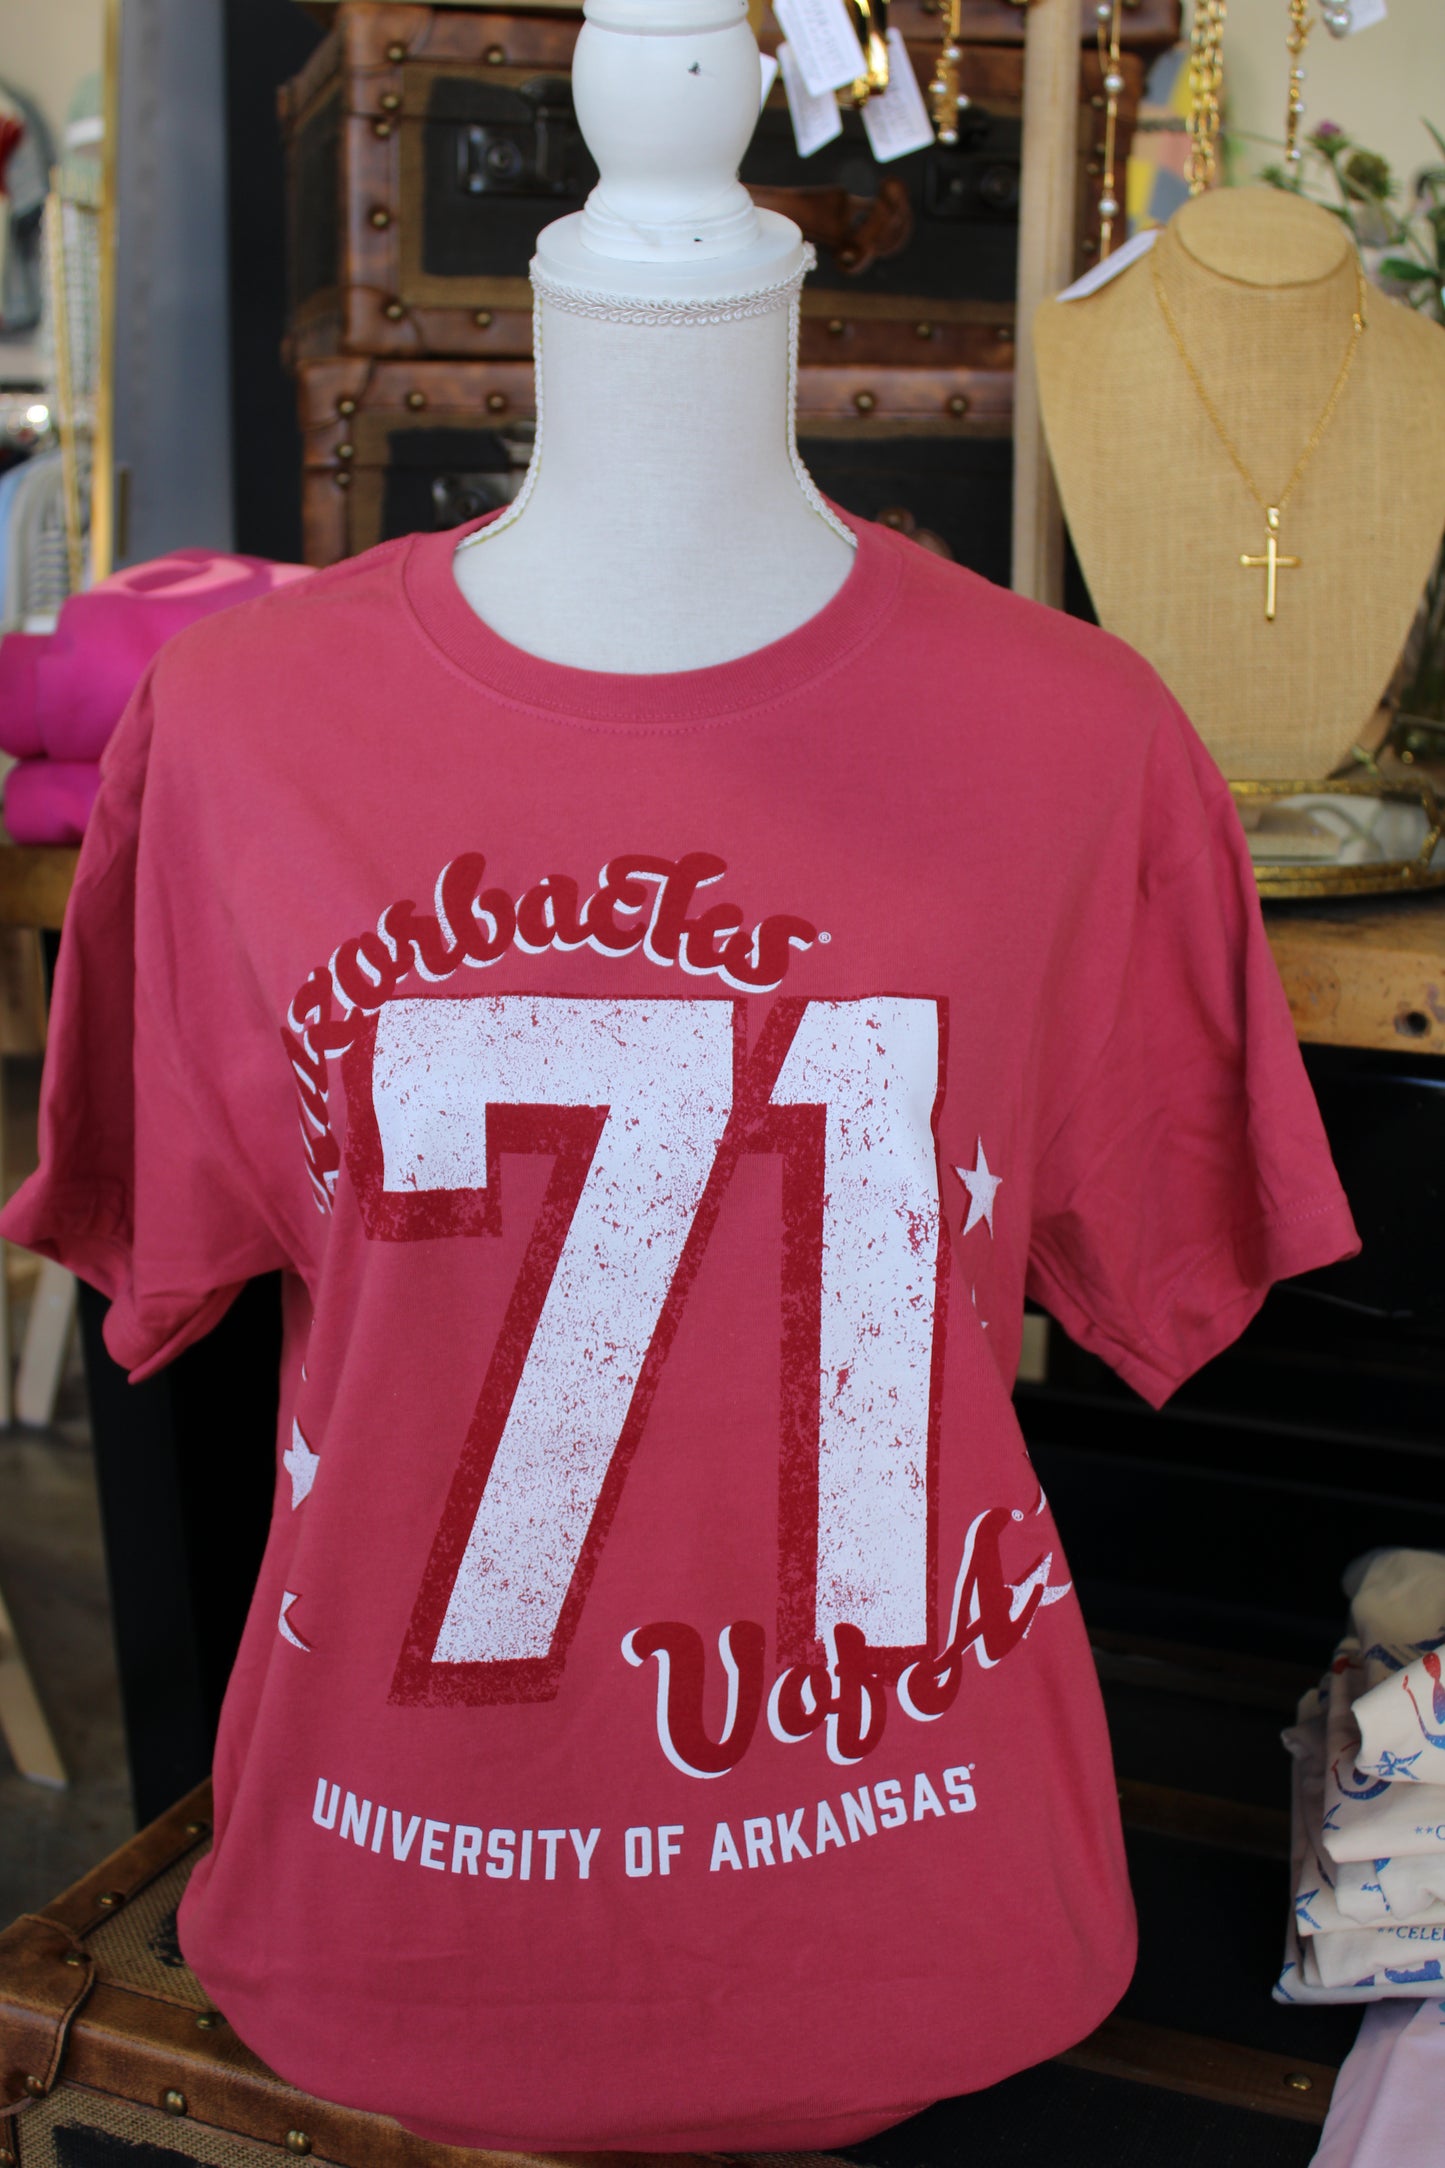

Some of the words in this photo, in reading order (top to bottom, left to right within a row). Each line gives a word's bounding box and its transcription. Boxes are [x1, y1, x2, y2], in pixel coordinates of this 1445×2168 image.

[341, 991, 949, 1706] 71
[312, 1777, 601, 1881] UNIVERSITY
[624, 1825, 685, 1878] OF
[709, 1764, 977, 1872] ARKANSAS
